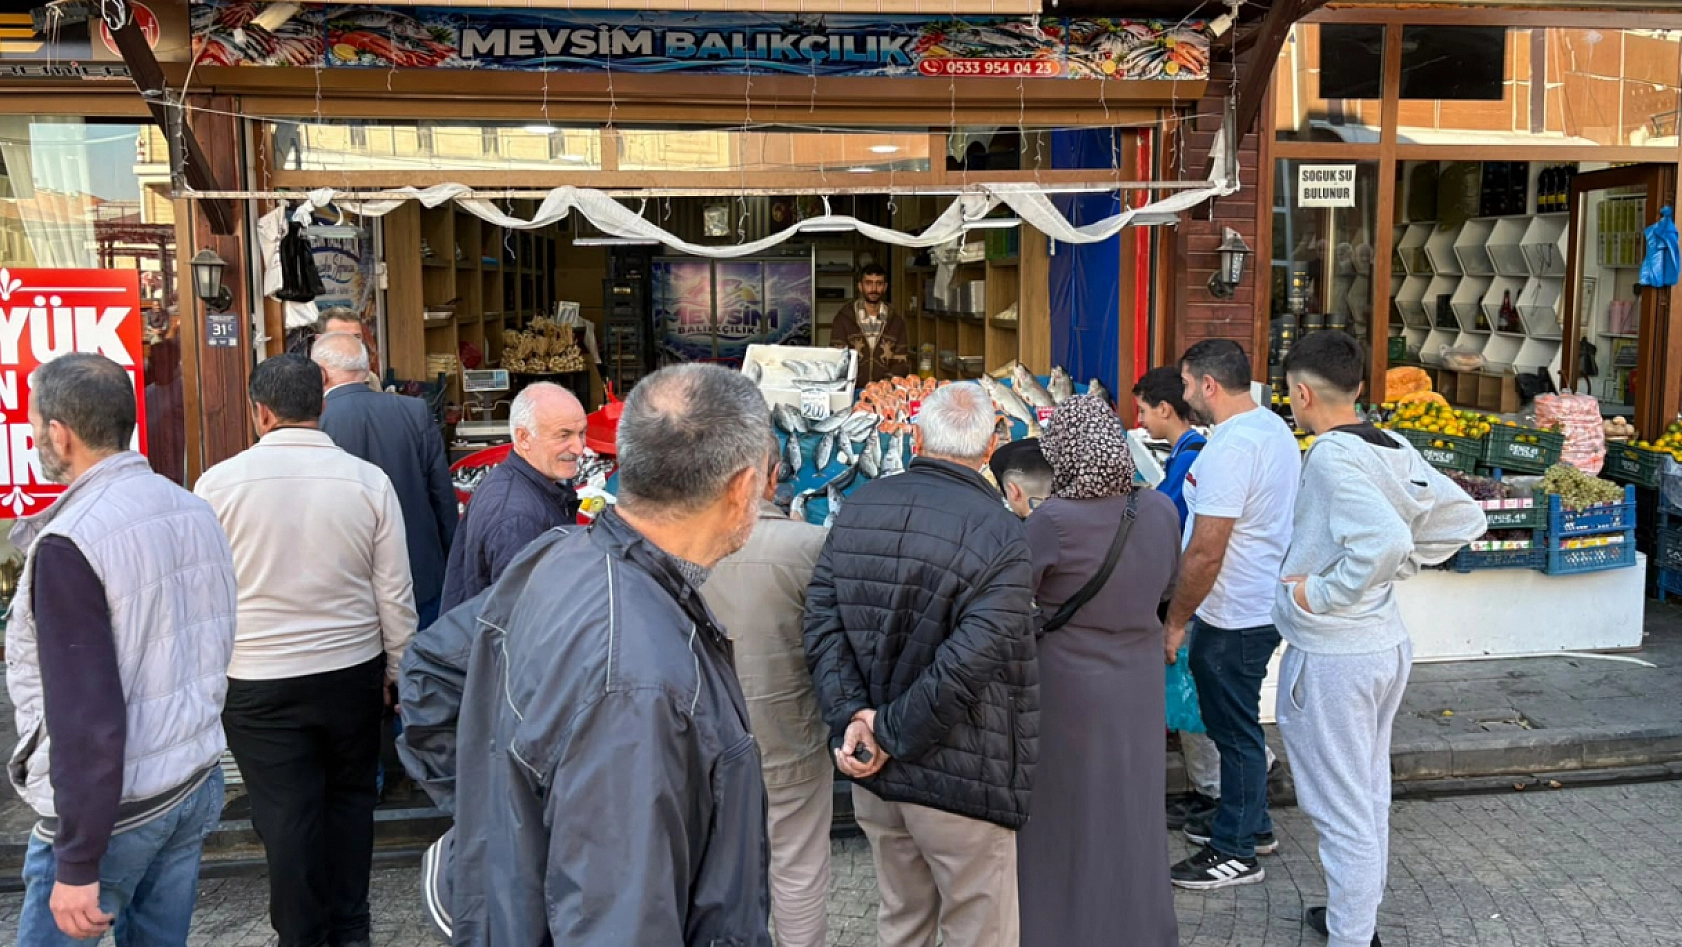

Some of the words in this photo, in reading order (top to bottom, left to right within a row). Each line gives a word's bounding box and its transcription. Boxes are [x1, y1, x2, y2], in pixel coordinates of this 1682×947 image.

[461, 25, 653, 57] MEVSİM
[666, 32, 911, 65] BALIKÇILIK
[946, 61, 980, 74] 0533
[984, 61, 1010, 74] 954
[1013, 61, 1032, 74] 04
[1035, 61, 1052, 74] 23
[1338, 170, 1353, 182] SU
[1303, 187, 1350, 200] BULUNUR
[654, 305, 779, 329] MEVSİM
